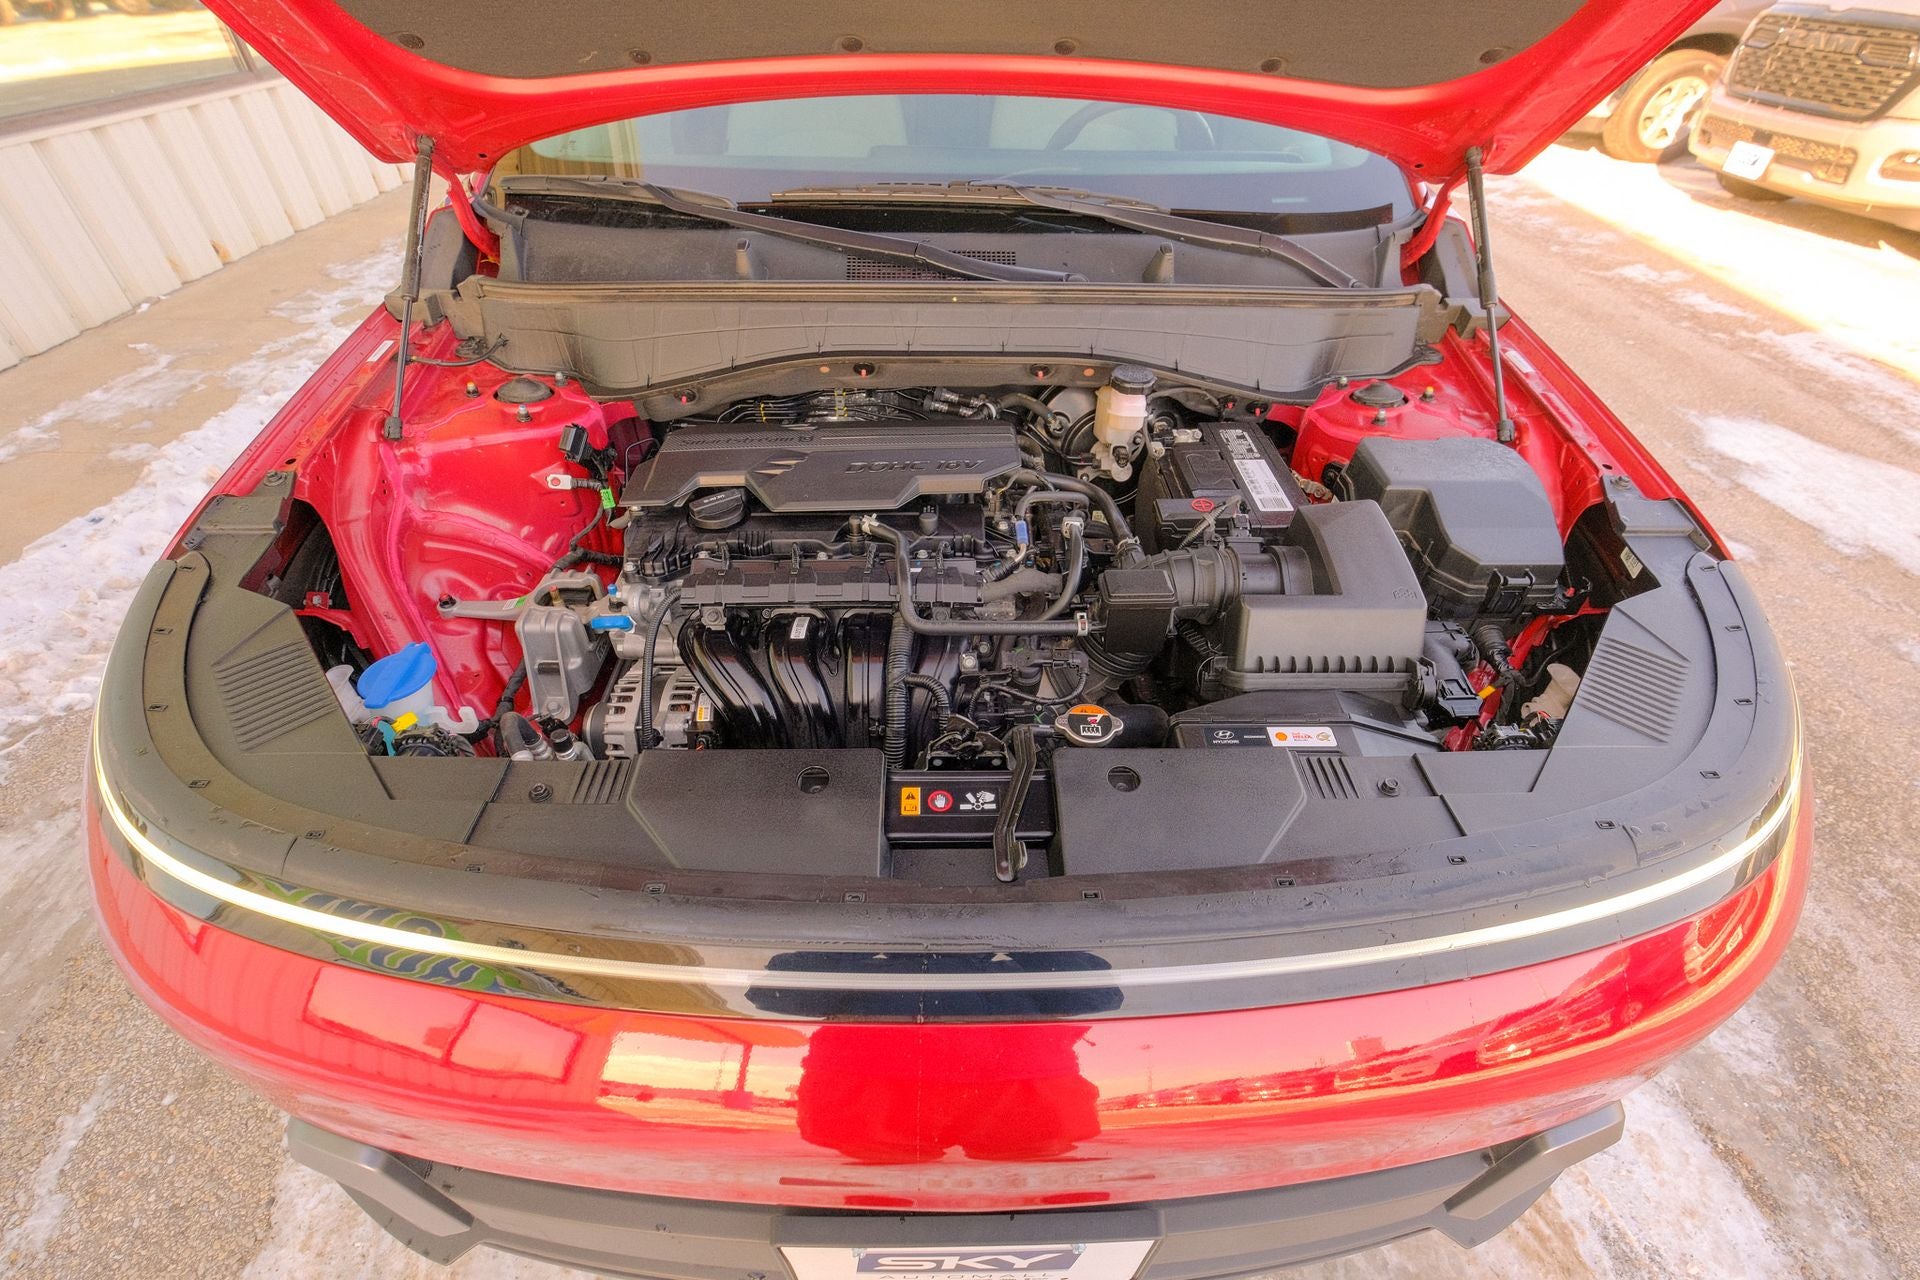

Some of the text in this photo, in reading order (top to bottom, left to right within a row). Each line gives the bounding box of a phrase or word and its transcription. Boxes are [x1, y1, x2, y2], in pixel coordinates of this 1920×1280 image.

[845, 460, 984, 474] DOHC 16V
[873, 1252, 1064, 1271] SKY
